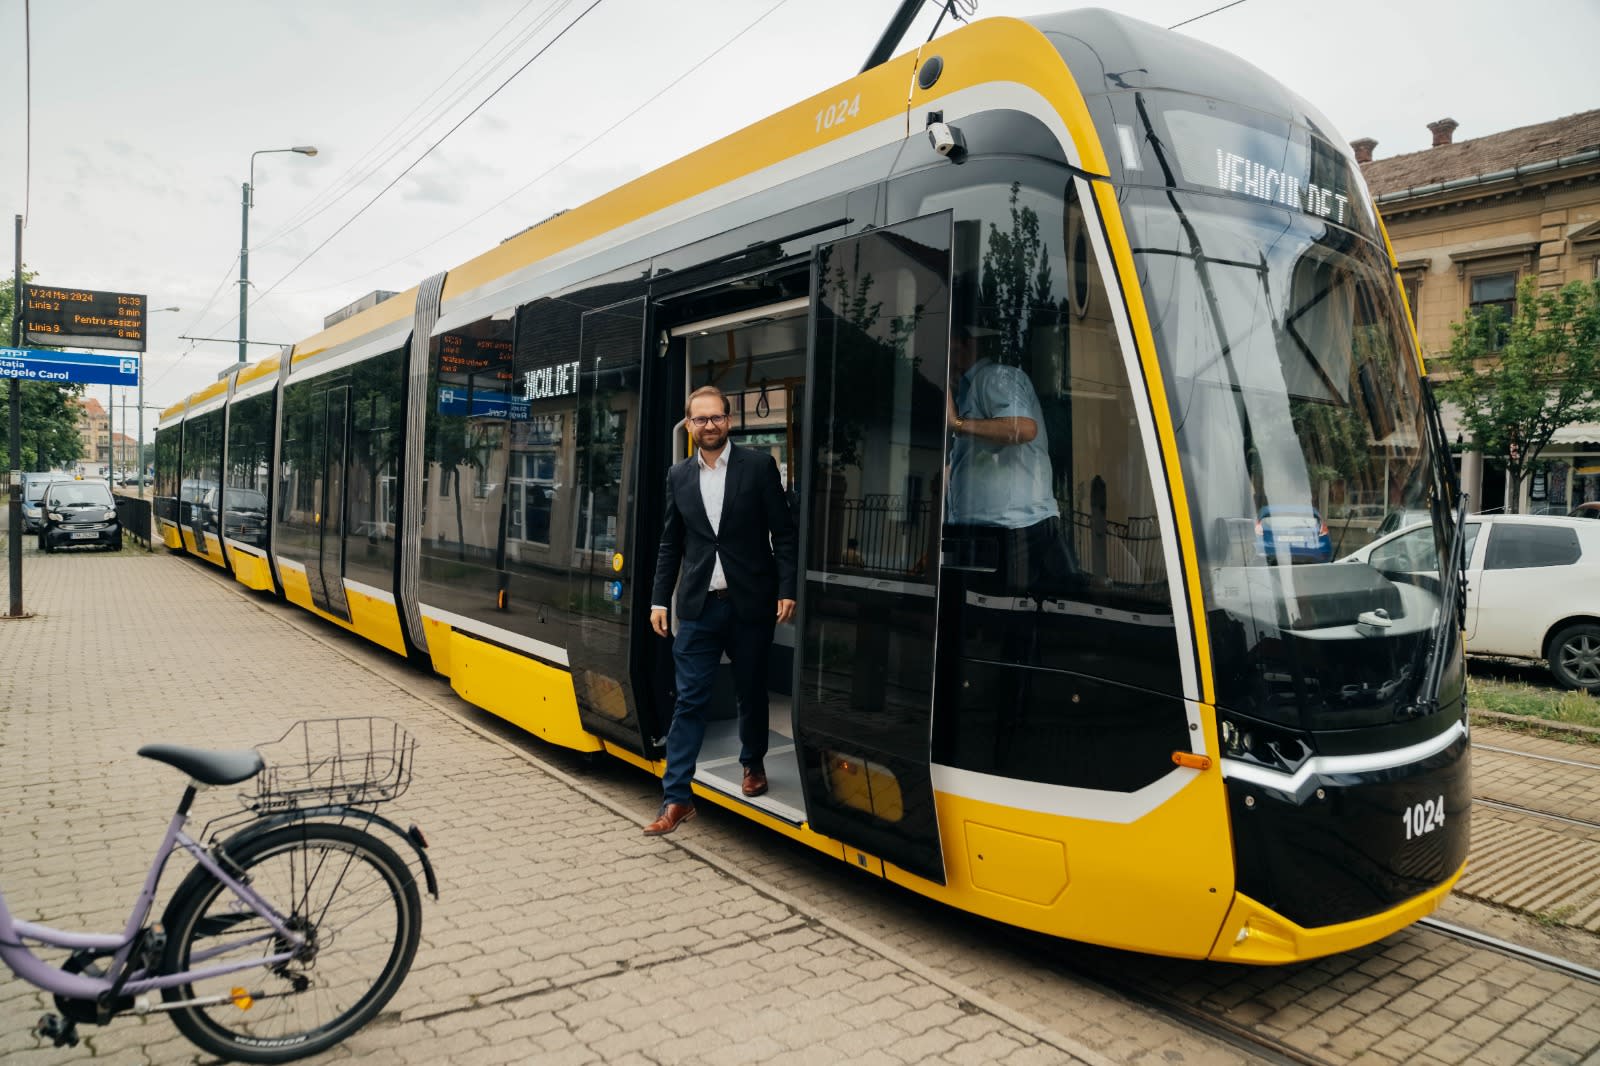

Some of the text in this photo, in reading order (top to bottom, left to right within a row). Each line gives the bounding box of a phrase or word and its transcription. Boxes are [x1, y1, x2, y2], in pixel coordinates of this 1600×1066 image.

[815, 93, 861, 133] 1024
[70, 292, 93, 302] 2024
[118, 296, 141, 306] 16:39
[29, 300, 60, 311] Linia 2
[74, 314, 141, 328] Pentru sesizar
[29, 322, 52, 332] Linia
[126, 331, 140, 339] min
[38, 370, 69, 380] Carol
[1403, 795, 1445, 840] 1024
[234, 1036, 307, 1047] WARRIOR
